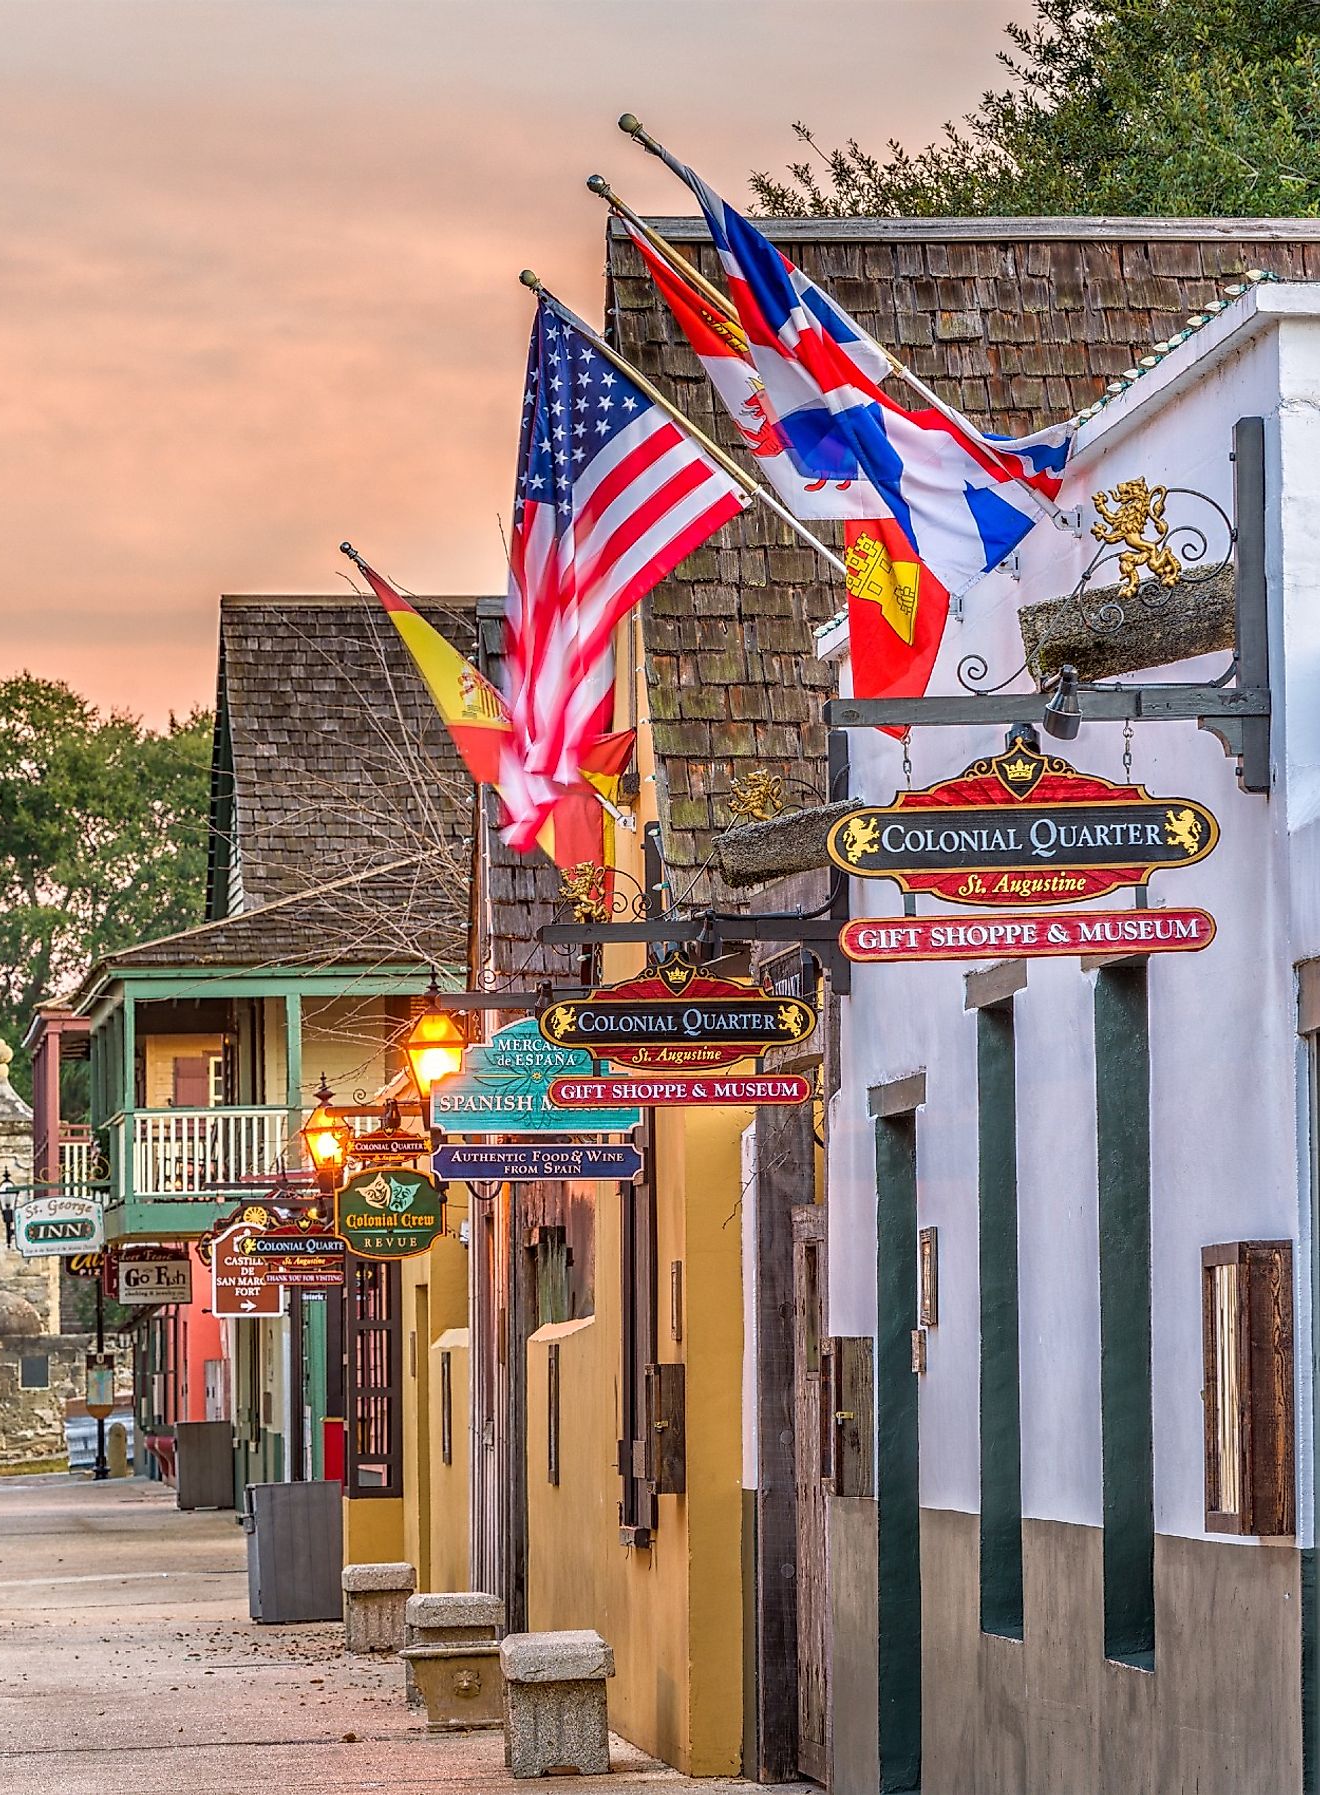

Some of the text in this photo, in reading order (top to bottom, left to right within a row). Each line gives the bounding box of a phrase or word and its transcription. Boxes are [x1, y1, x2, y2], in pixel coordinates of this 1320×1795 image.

[881, 818, 1164, 859] COLONIAL QUARTER
[958, 871, 1087, 897] St. Augustine
[857, 917, 1201, 950] GIFT SHOPPE & MUSEUM
[578, 1008, 777, 1037] COLONIAL QUARTER
[498, 1039, 572, 1052] MERCA
[497, 1052, 577, 1066] de ESPAÑA
[631, 1046, 723, 1064] St. Augustine
[560, 1082, 799, 1100] GIFT SHOPPE & MUSEUM
[440, 1095, 533, 1113] SPANISH
[355, 1141, 424, 1153] COLONIAL QUARTER
[450, 1150, 528, 1162] AUTHENTIC
[586, 1150, 624, 1162] WINE
[503, 1162, 582, 1174] FROM SPAIN
[24, 1199, 92, 1219] St. George
[345, 1213, 435, 1229] Colonial Crew
[38, 1222, 82, 1239] INN
[256, 1238, 345, 1254] COLONIAL QUARTE
[364, 1237, 418, 1248] REVUE
[224, 1256, 269, 1266] CASTILL
[125, 1268, 150, 1287] Go
[240, 1267, 255, 1276] DE
[266, 1274, 343, 1282] THANK YOU FOR VISITING
[216, 1278, 267, 1287] SAN MARC
[235, 1287, 261, 1297] FORT
